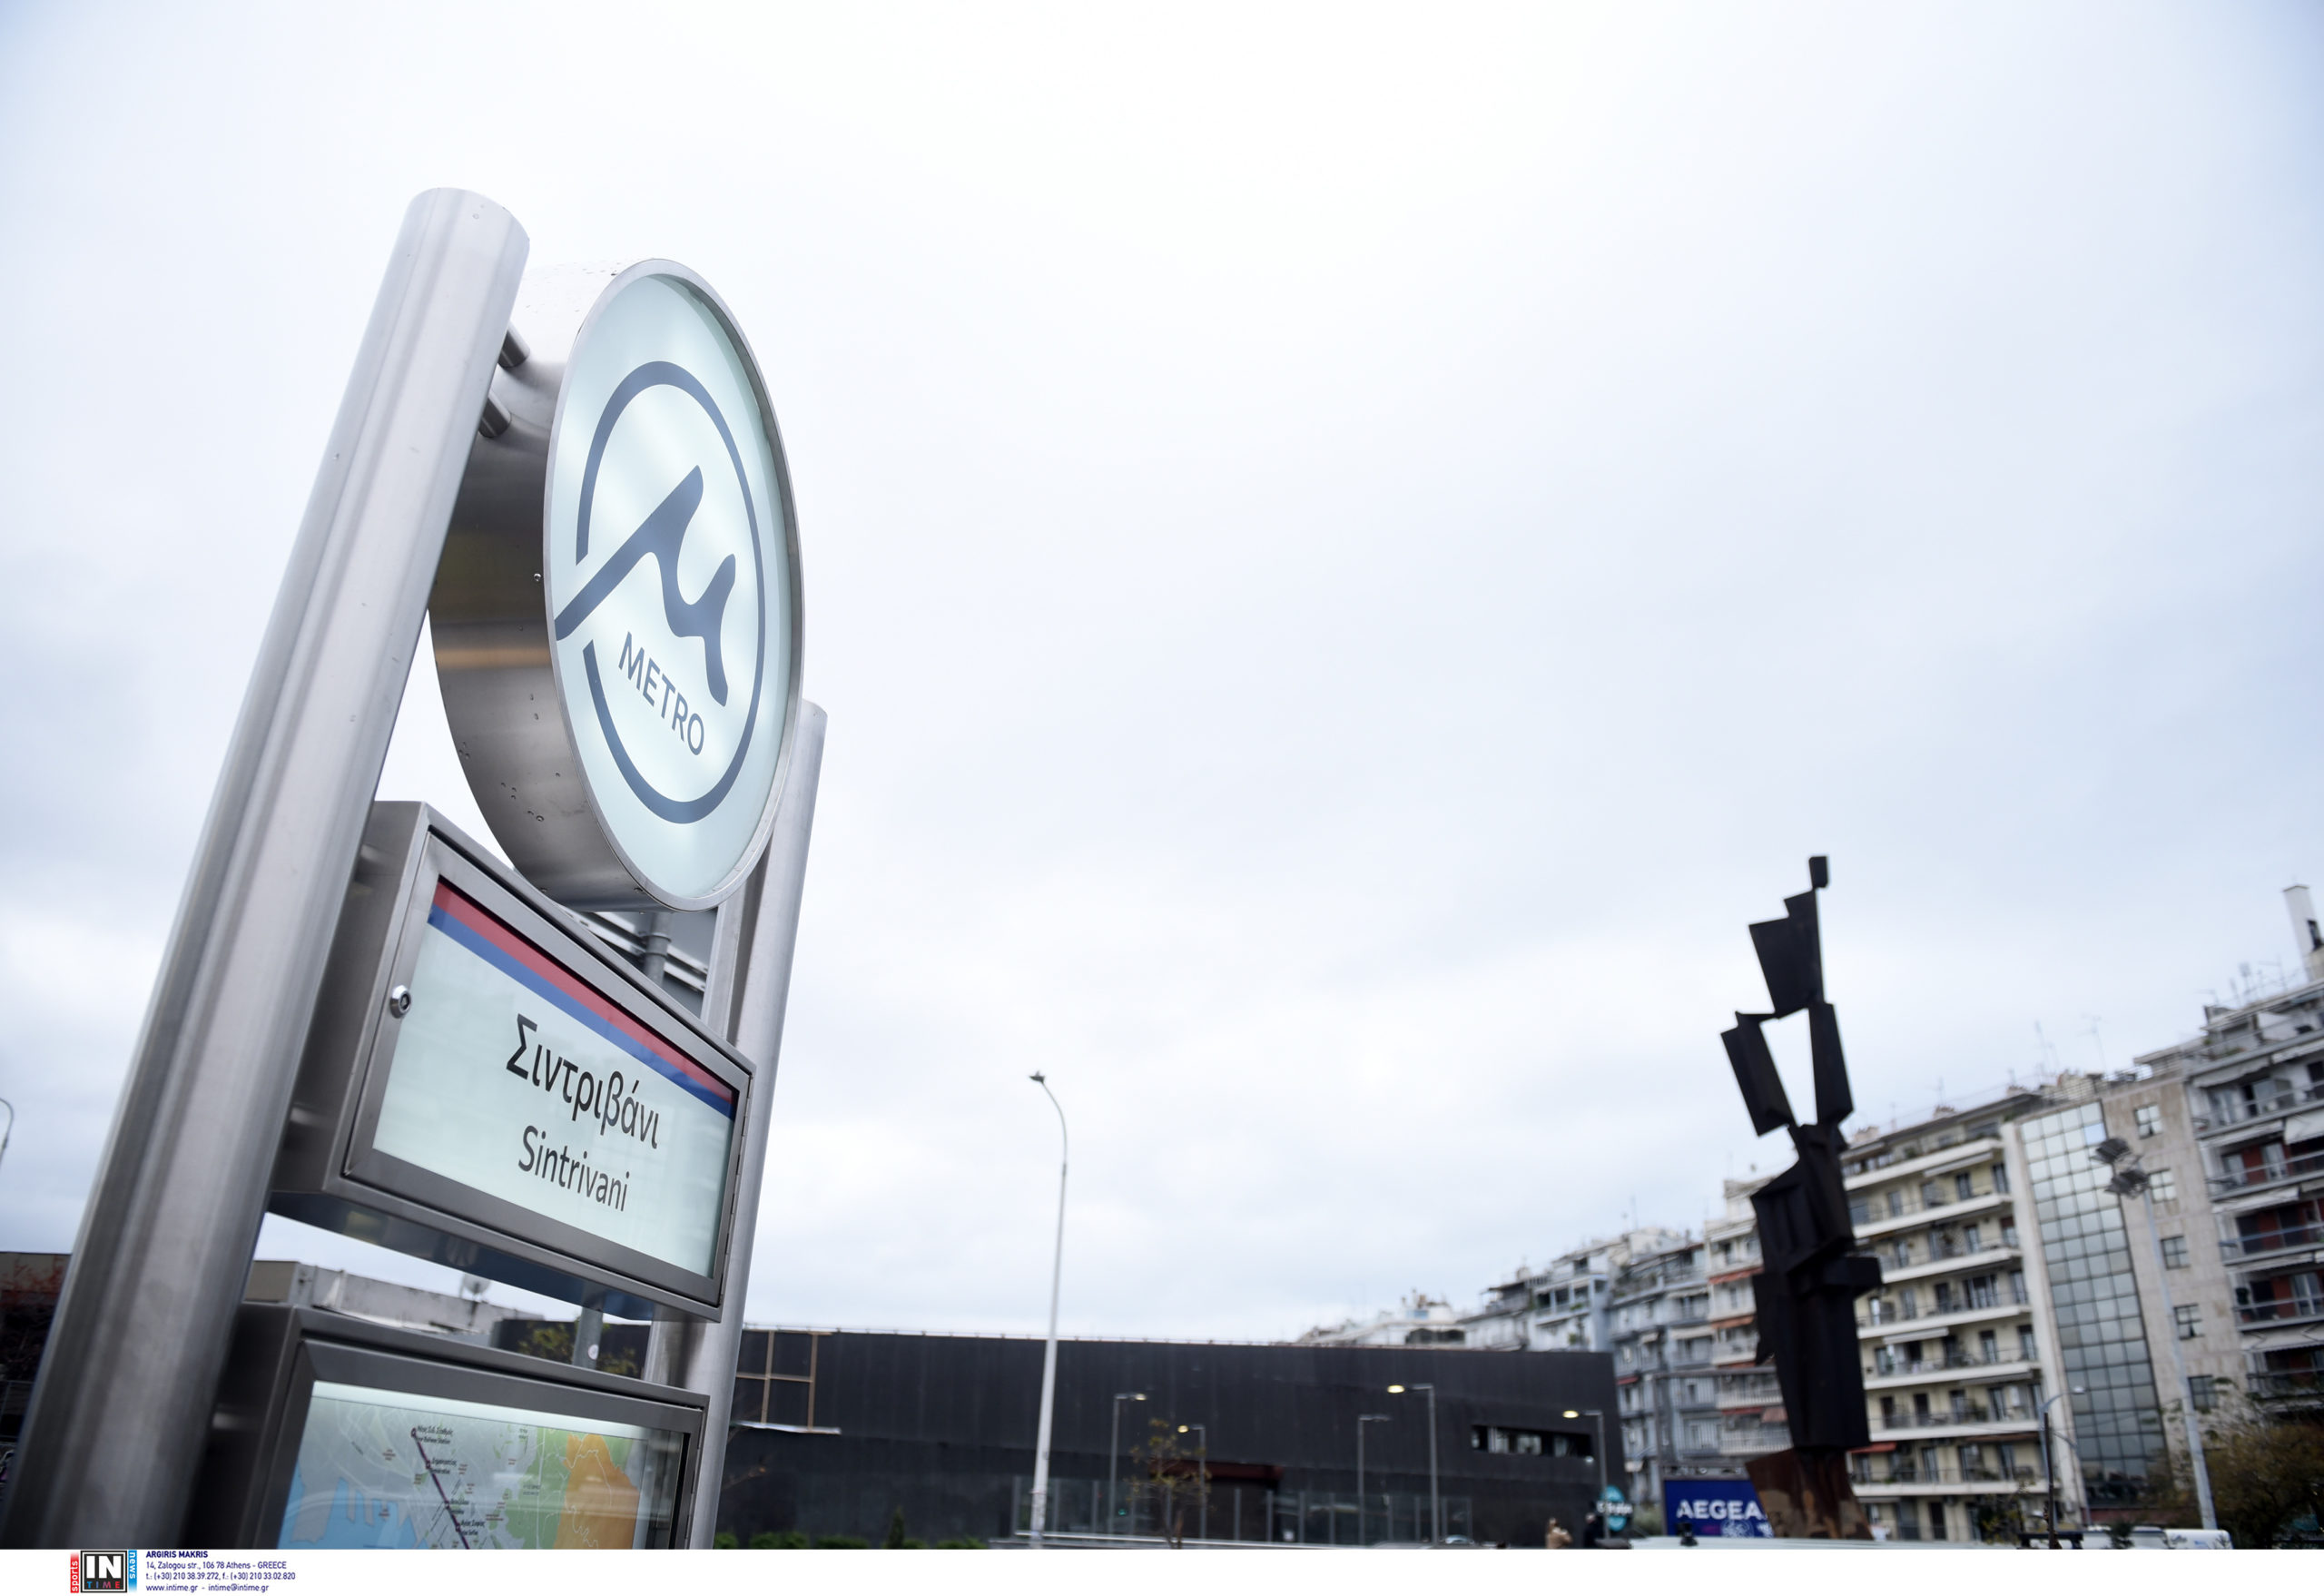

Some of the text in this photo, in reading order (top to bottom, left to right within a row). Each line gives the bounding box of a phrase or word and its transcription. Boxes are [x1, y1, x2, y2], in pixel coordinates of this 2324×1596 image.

[618, 631, 704, 756] METRO
[506, 1012, 660, 1149] Σιντριβάνι
[517, 1125, 631, 1212] Sintrivani
[1676, 1499, 1768, 1521] AEGEA
